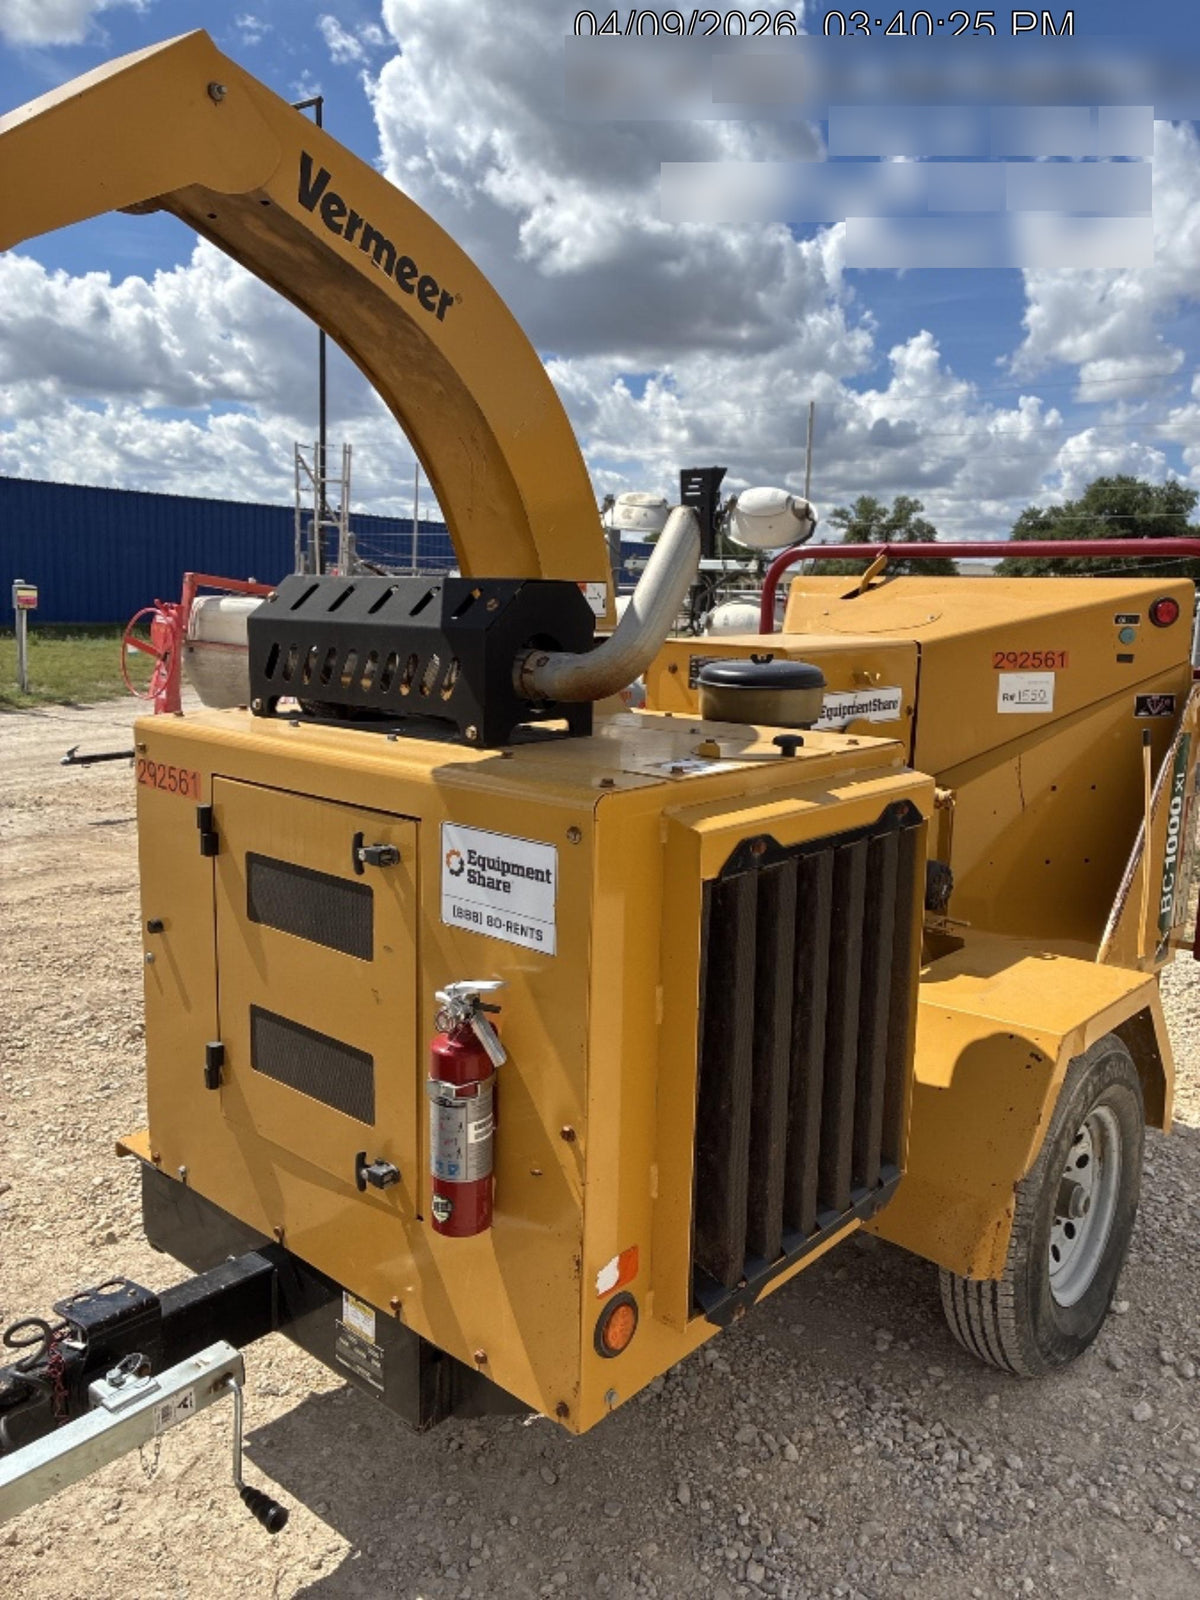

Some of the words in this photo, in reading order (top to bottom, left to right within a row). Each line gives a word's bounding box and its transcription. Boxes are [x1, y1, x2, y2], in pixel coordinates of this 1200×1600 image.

[298, 151, 454, 322] Vermeer
[993, 651, 1066, 669] 292561
[137, 759, 199, 800] 292561
[467, 849, 552, 884] Equipment
[467, 869, 511, 893] Share
